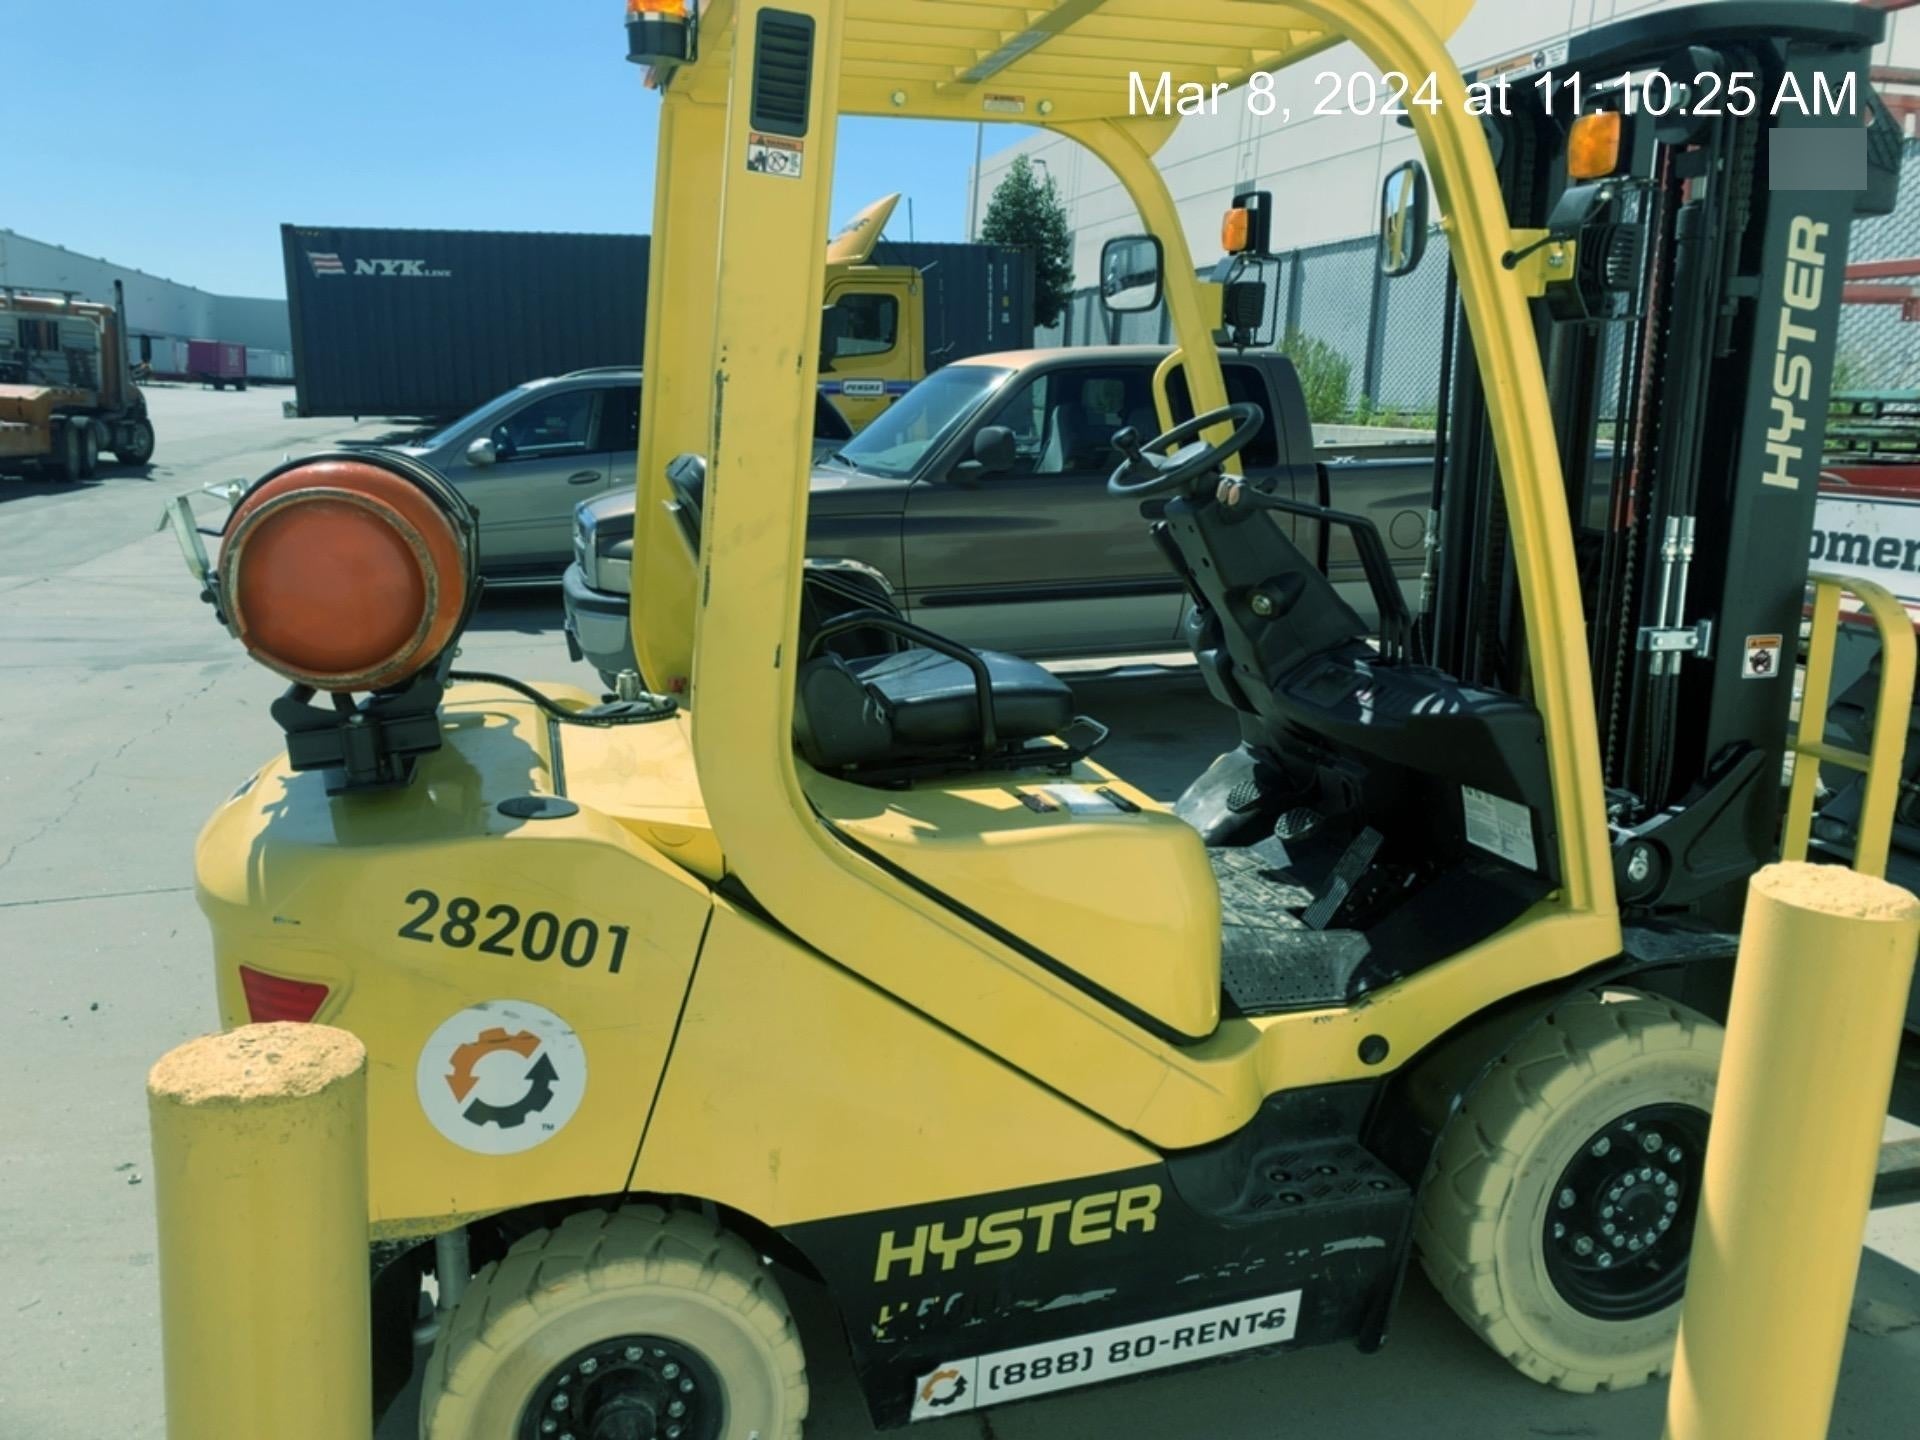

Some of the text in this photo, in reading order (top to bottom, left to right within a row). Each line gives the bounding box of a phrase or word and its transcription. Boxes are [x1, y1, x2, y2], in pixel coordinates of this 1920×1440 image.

[353, 258, 426, 277] NYK
[1761, 215, 1829, 490] HYSTER
[398, 889, 630, 974] 282001
[874, 1184, 1162, 1282] HYSTER
[989, 1346, 1094, 1391] (888)
